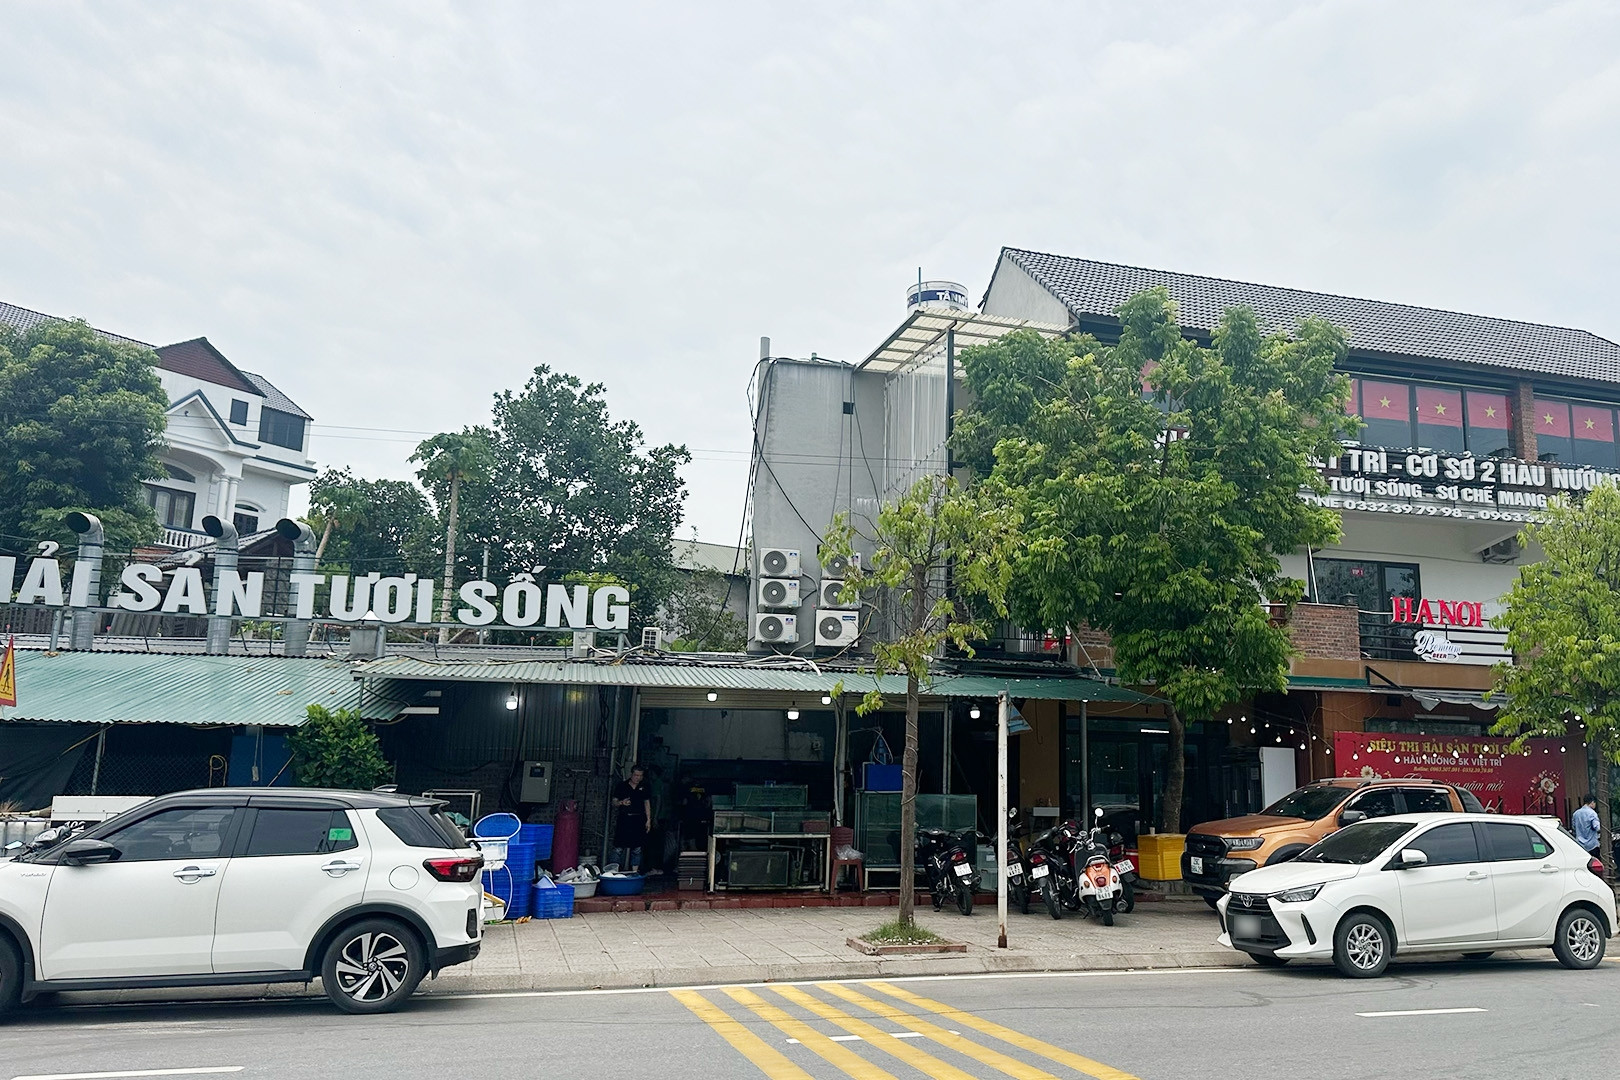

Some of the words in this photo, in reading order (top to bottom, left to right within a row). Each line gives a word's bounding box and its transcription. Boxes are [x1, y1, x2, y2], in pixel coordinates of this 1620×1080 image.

[1347, 446, 1387, 473] TRÌ
[1405, 454, 1438, 478] CƠ
[1443, 451, 1475, 480] SỞ
[1480, 461, 1496, 482] 2
[1500, 458, 1546, 487] HÀU
[1343, 500, 1388, 512] 0332
[1374, 478, 1424, 498] SỐNG
[1435, 485, 1458, 501] SƠ
[1497, 490, 1547, 508] MANG
[115, 550, 265, 616] SẢN
[289, 571, 434, 624] TƯƠI
[457, 565, 630, 630] SỐNG
[1390, 596, 1483, 627] HANOI
[1403, 755, 1422, 764] HÀU
[1458, 758, 1470, 766] 5K
[1489, 757, 1502, 767] TRÌ
